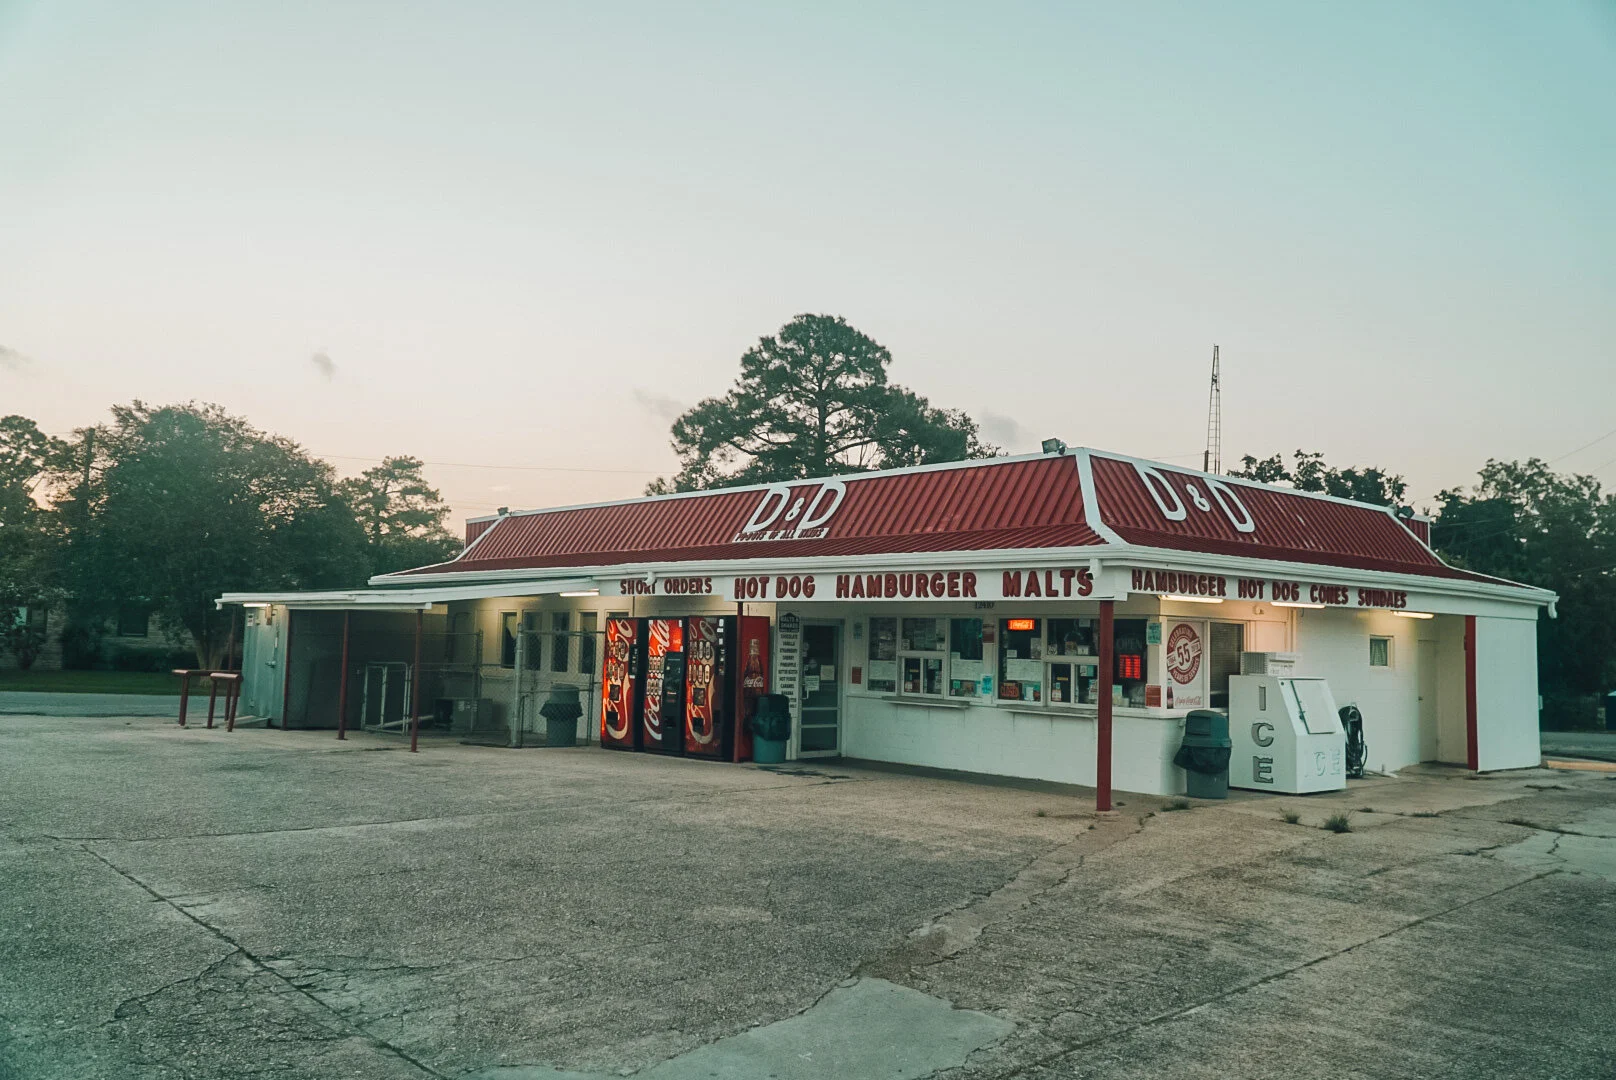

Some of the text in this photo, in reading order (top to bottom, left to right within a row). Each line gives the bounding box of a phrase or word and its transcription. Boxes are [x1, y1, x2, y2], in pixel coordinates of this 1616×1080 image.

[664, 577, 713, 594] ORDERS
[734, 575, 816, 599] HOT DOG
[836, 571, 977, 598] HAMBURGER
[1002, 569, 1093, 597] MALTS
[1131, 568, 1408, 609] HAMBURGER HOT DOG CONES SUNDAES
[1177, 642, 1191, 667] 55
[1250, 685, 1275, 784] ICE
